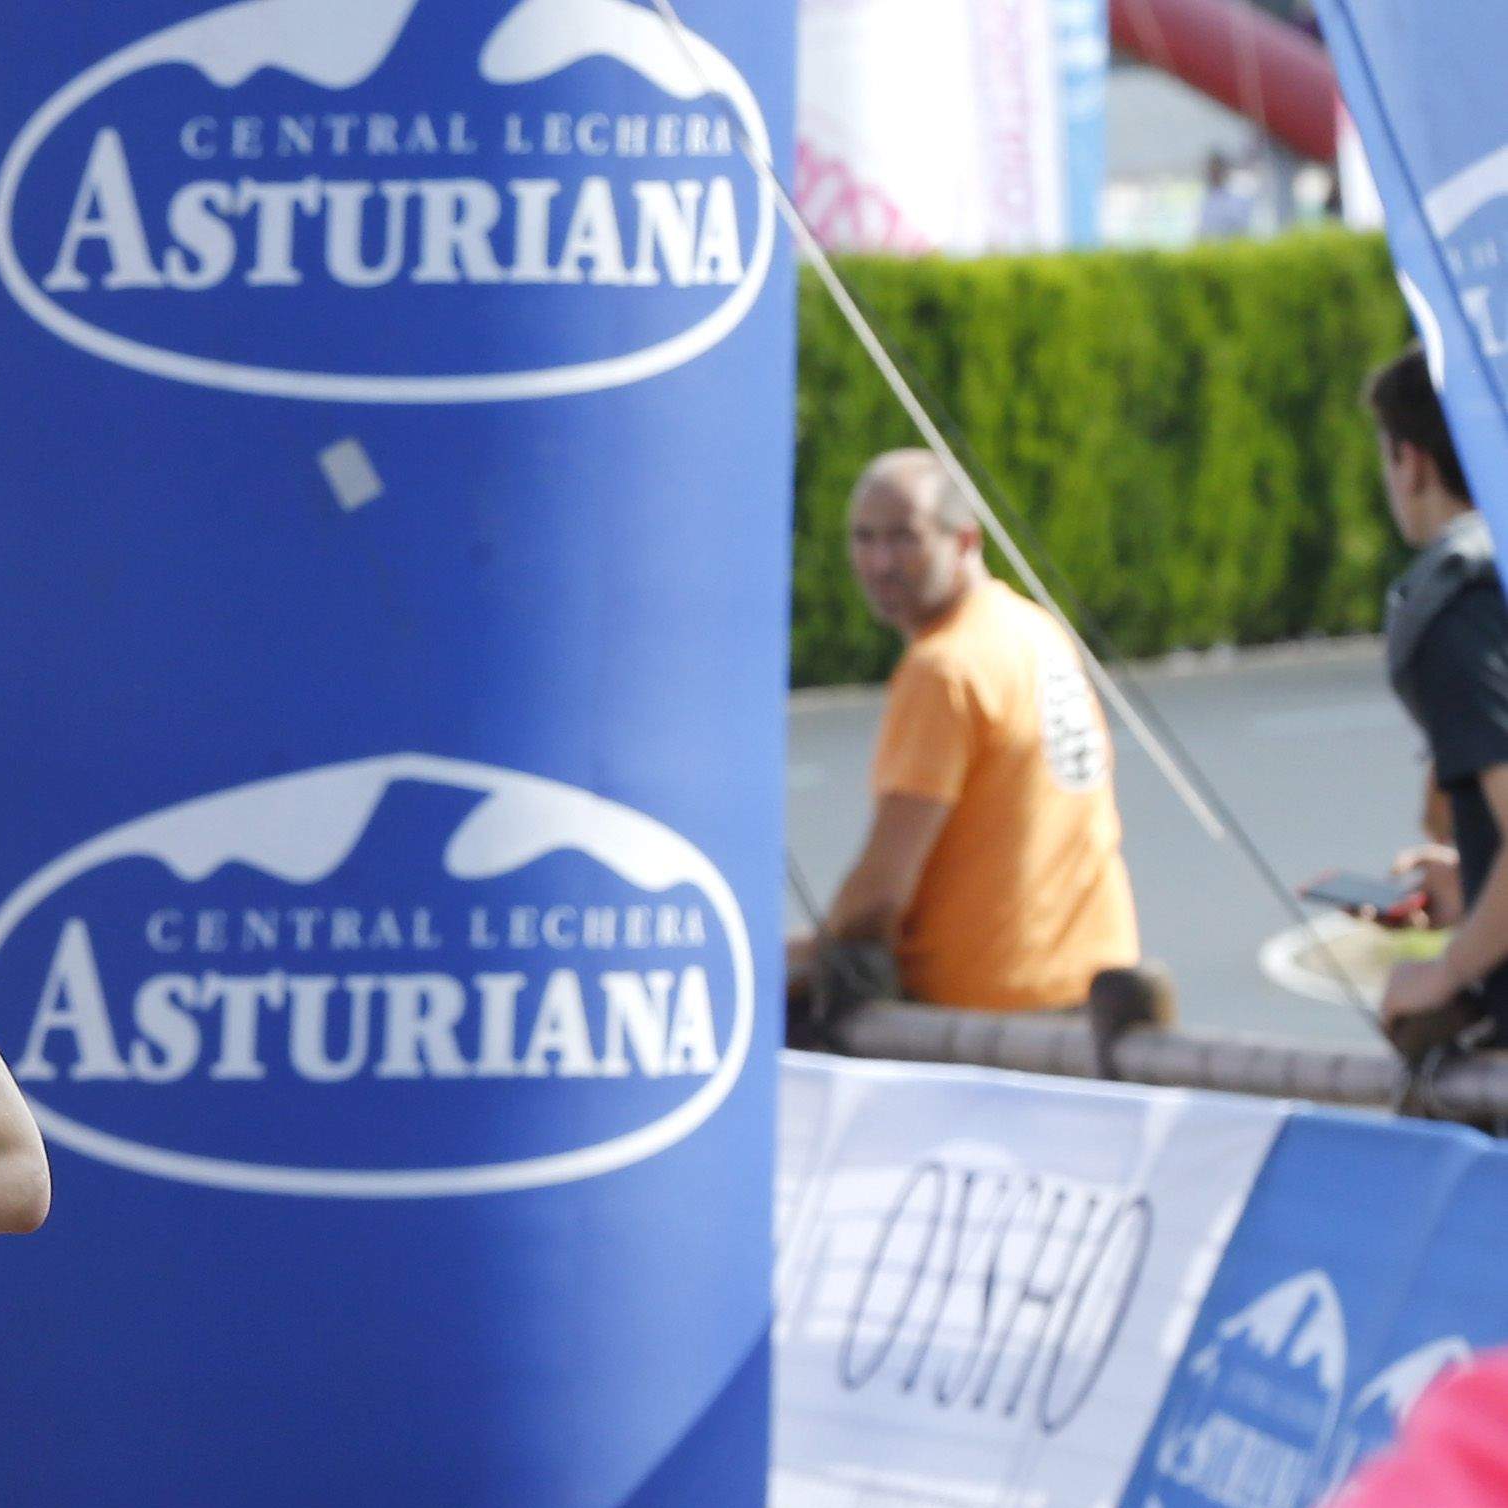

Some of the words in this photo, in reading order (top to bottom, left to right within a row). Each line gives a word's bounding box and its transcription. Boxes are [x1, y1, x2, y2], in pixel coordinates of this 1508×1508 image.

[180, 112, 478, 159] CENTRAL
[43, 125, 745, 291] ASTURIANA
[145, 905, 442, 953] CENTRAL
[467, 903, 707, 950] LECHERA
[14, 916, 721, 1084] ASTURIANA
